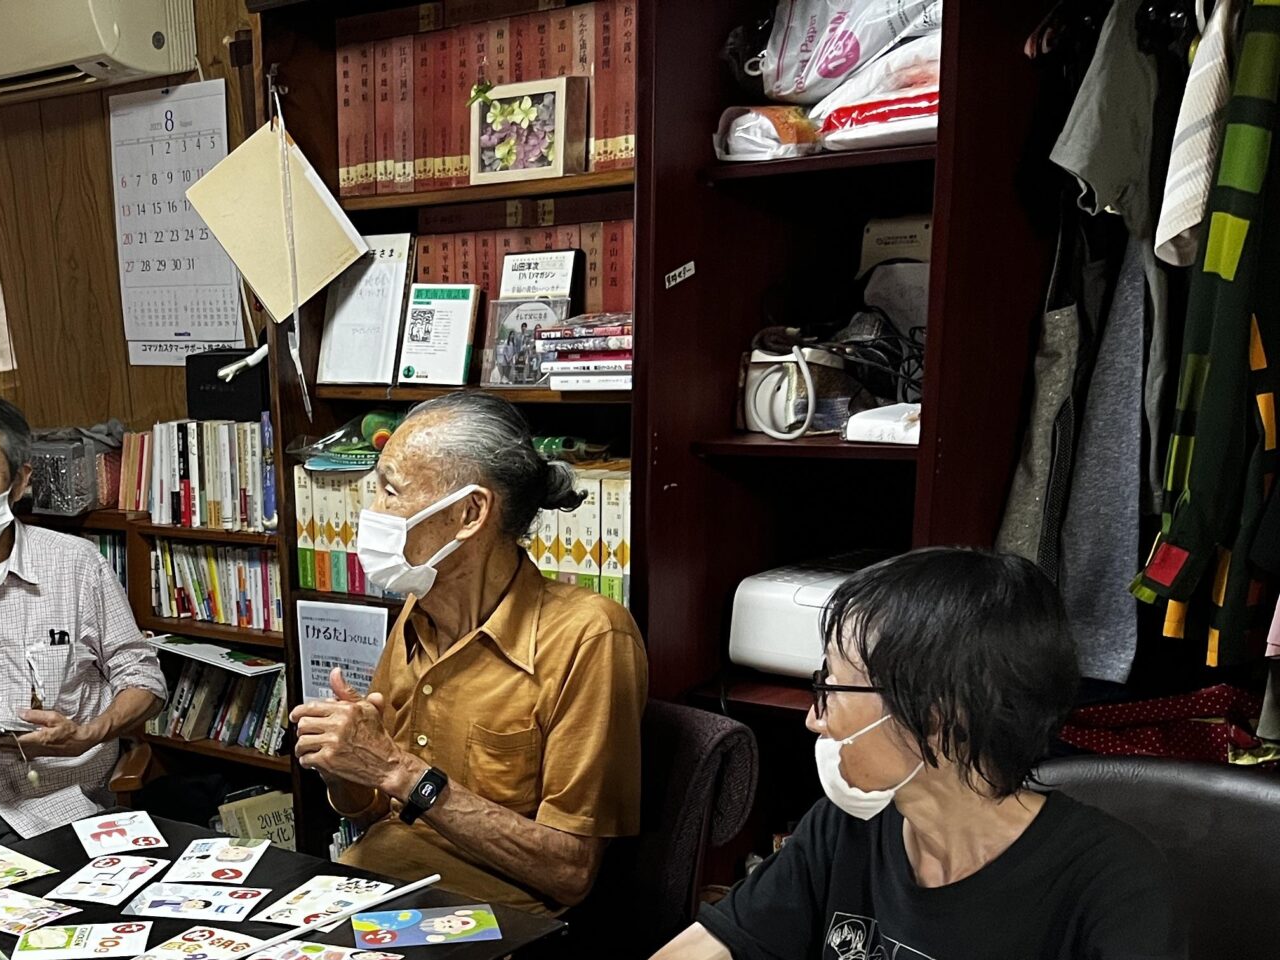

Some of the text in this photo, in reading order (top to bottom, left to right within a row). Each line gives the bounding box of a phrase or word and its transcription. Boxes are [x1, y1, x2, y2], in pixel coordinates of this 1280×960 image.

[800, 14, 817, 53] Paper
[164, 110, 174, 132] 8
[165, 142, 171, 154] 2
[182, 140, 187, 152] 3
[196, 138, 201, 149] 4
[210, 137, 215, 149] 5
[121, 176, 127, 188] 6
[136, 175, 141, 187] 7
[151, 174, 158, 185] 8
[167, 171, 173, 184] 9
[182, 170, 191, 182] 10
[122, 205, 130, 216] 13
[137, 203, 145, 215] 14
[152, 203, 161, 214] 15
[168, 201, 177, 213] 16
[123, 228, 209, 245] 20 21 22 23 24 25
[126, 258, 194, 272] 27 28 29 30 31
[75, 927, 88, 947] CHICKEN
